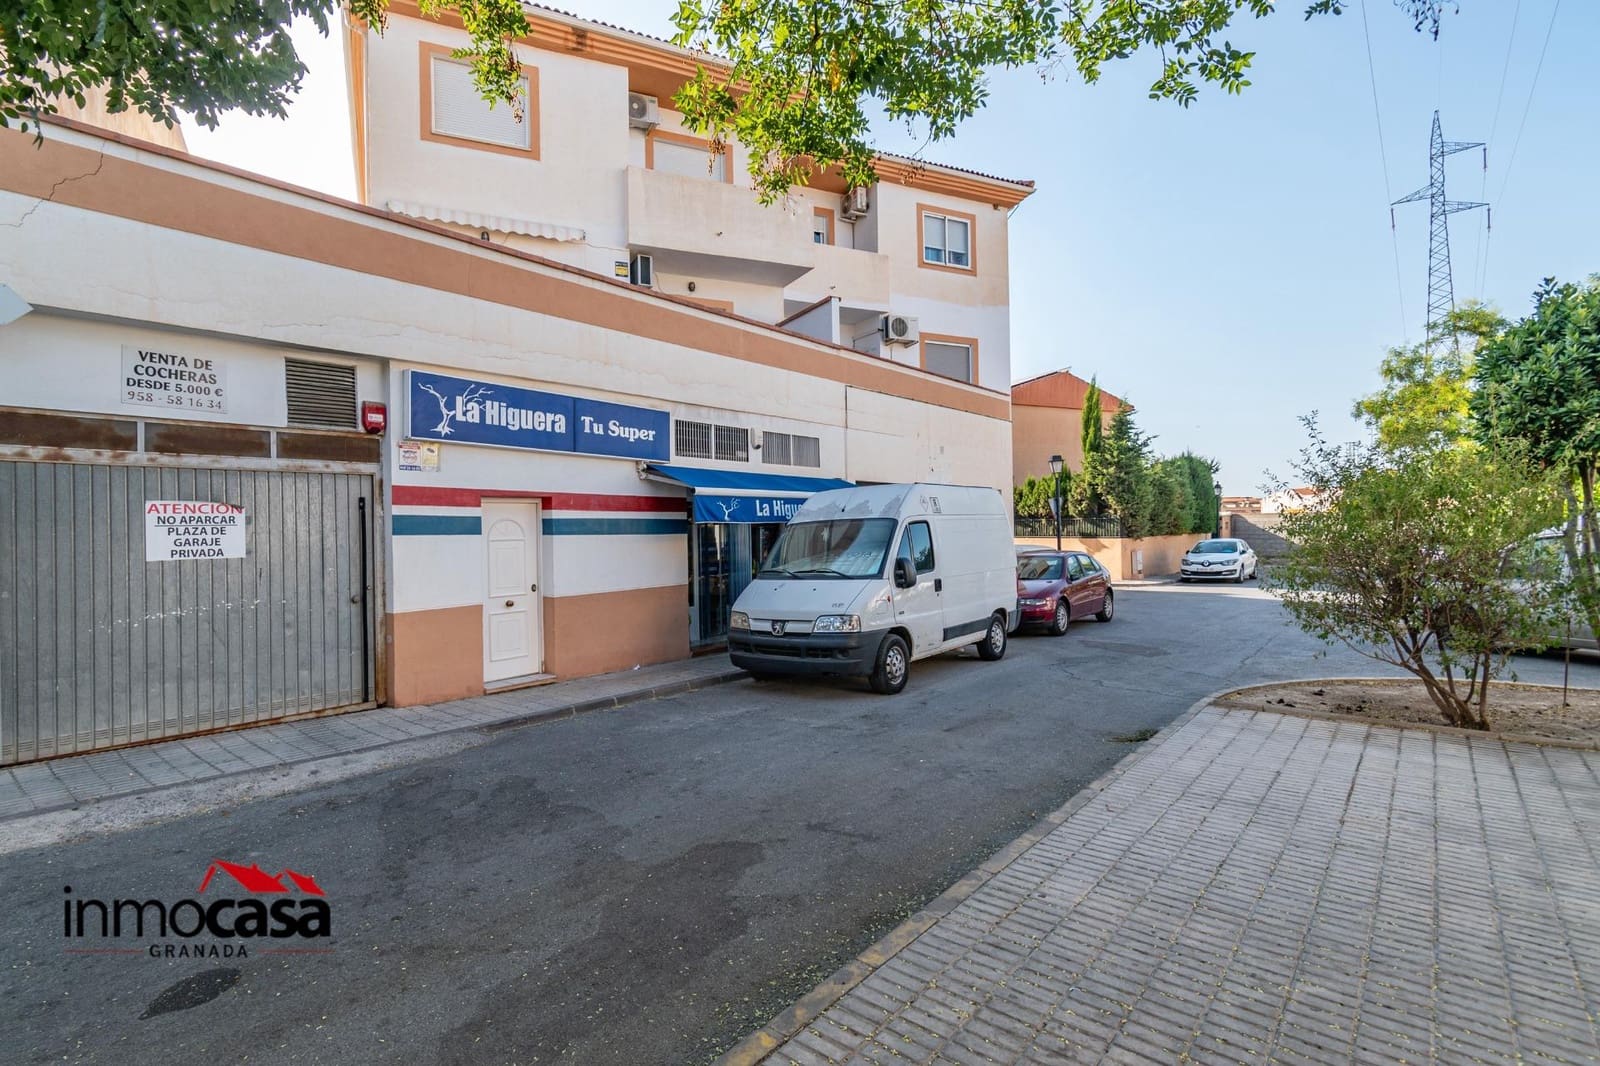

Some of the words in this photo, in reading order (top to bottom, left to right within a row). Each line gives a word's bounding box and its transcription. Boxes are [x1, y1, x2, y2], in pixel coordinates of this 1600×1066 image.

[138, 350, 188, 368] VENTA
[193, 358, 213, 371] DE
[133, 364, 217, 385] COCHERAS
[126, 377, 171, 391] DESDE
[175, 383, 211, 396] 5.000
[214, 388, 224, 397] €
[127, 390, 153, 402] 958
[167, 394, 183, 406] 58
[206, 399, 222, 409] 34
[455, 395, 480, 424] La
[485, 399, 566, 434] Higuera
[581, 415, 605, 435] Tu
[608, 419, 656, 442] Super
[755, 499, 770, 517] La
[157, 515, 177, 525] NO
[179, 515, 236, 525] APARCAR
[167, 526, 208, 536] PLAZA
[211, 526, 227, 536] DE
[173, 537, 222, 547] GARAJE
[170, 548, 224, 559] PRIVADA
